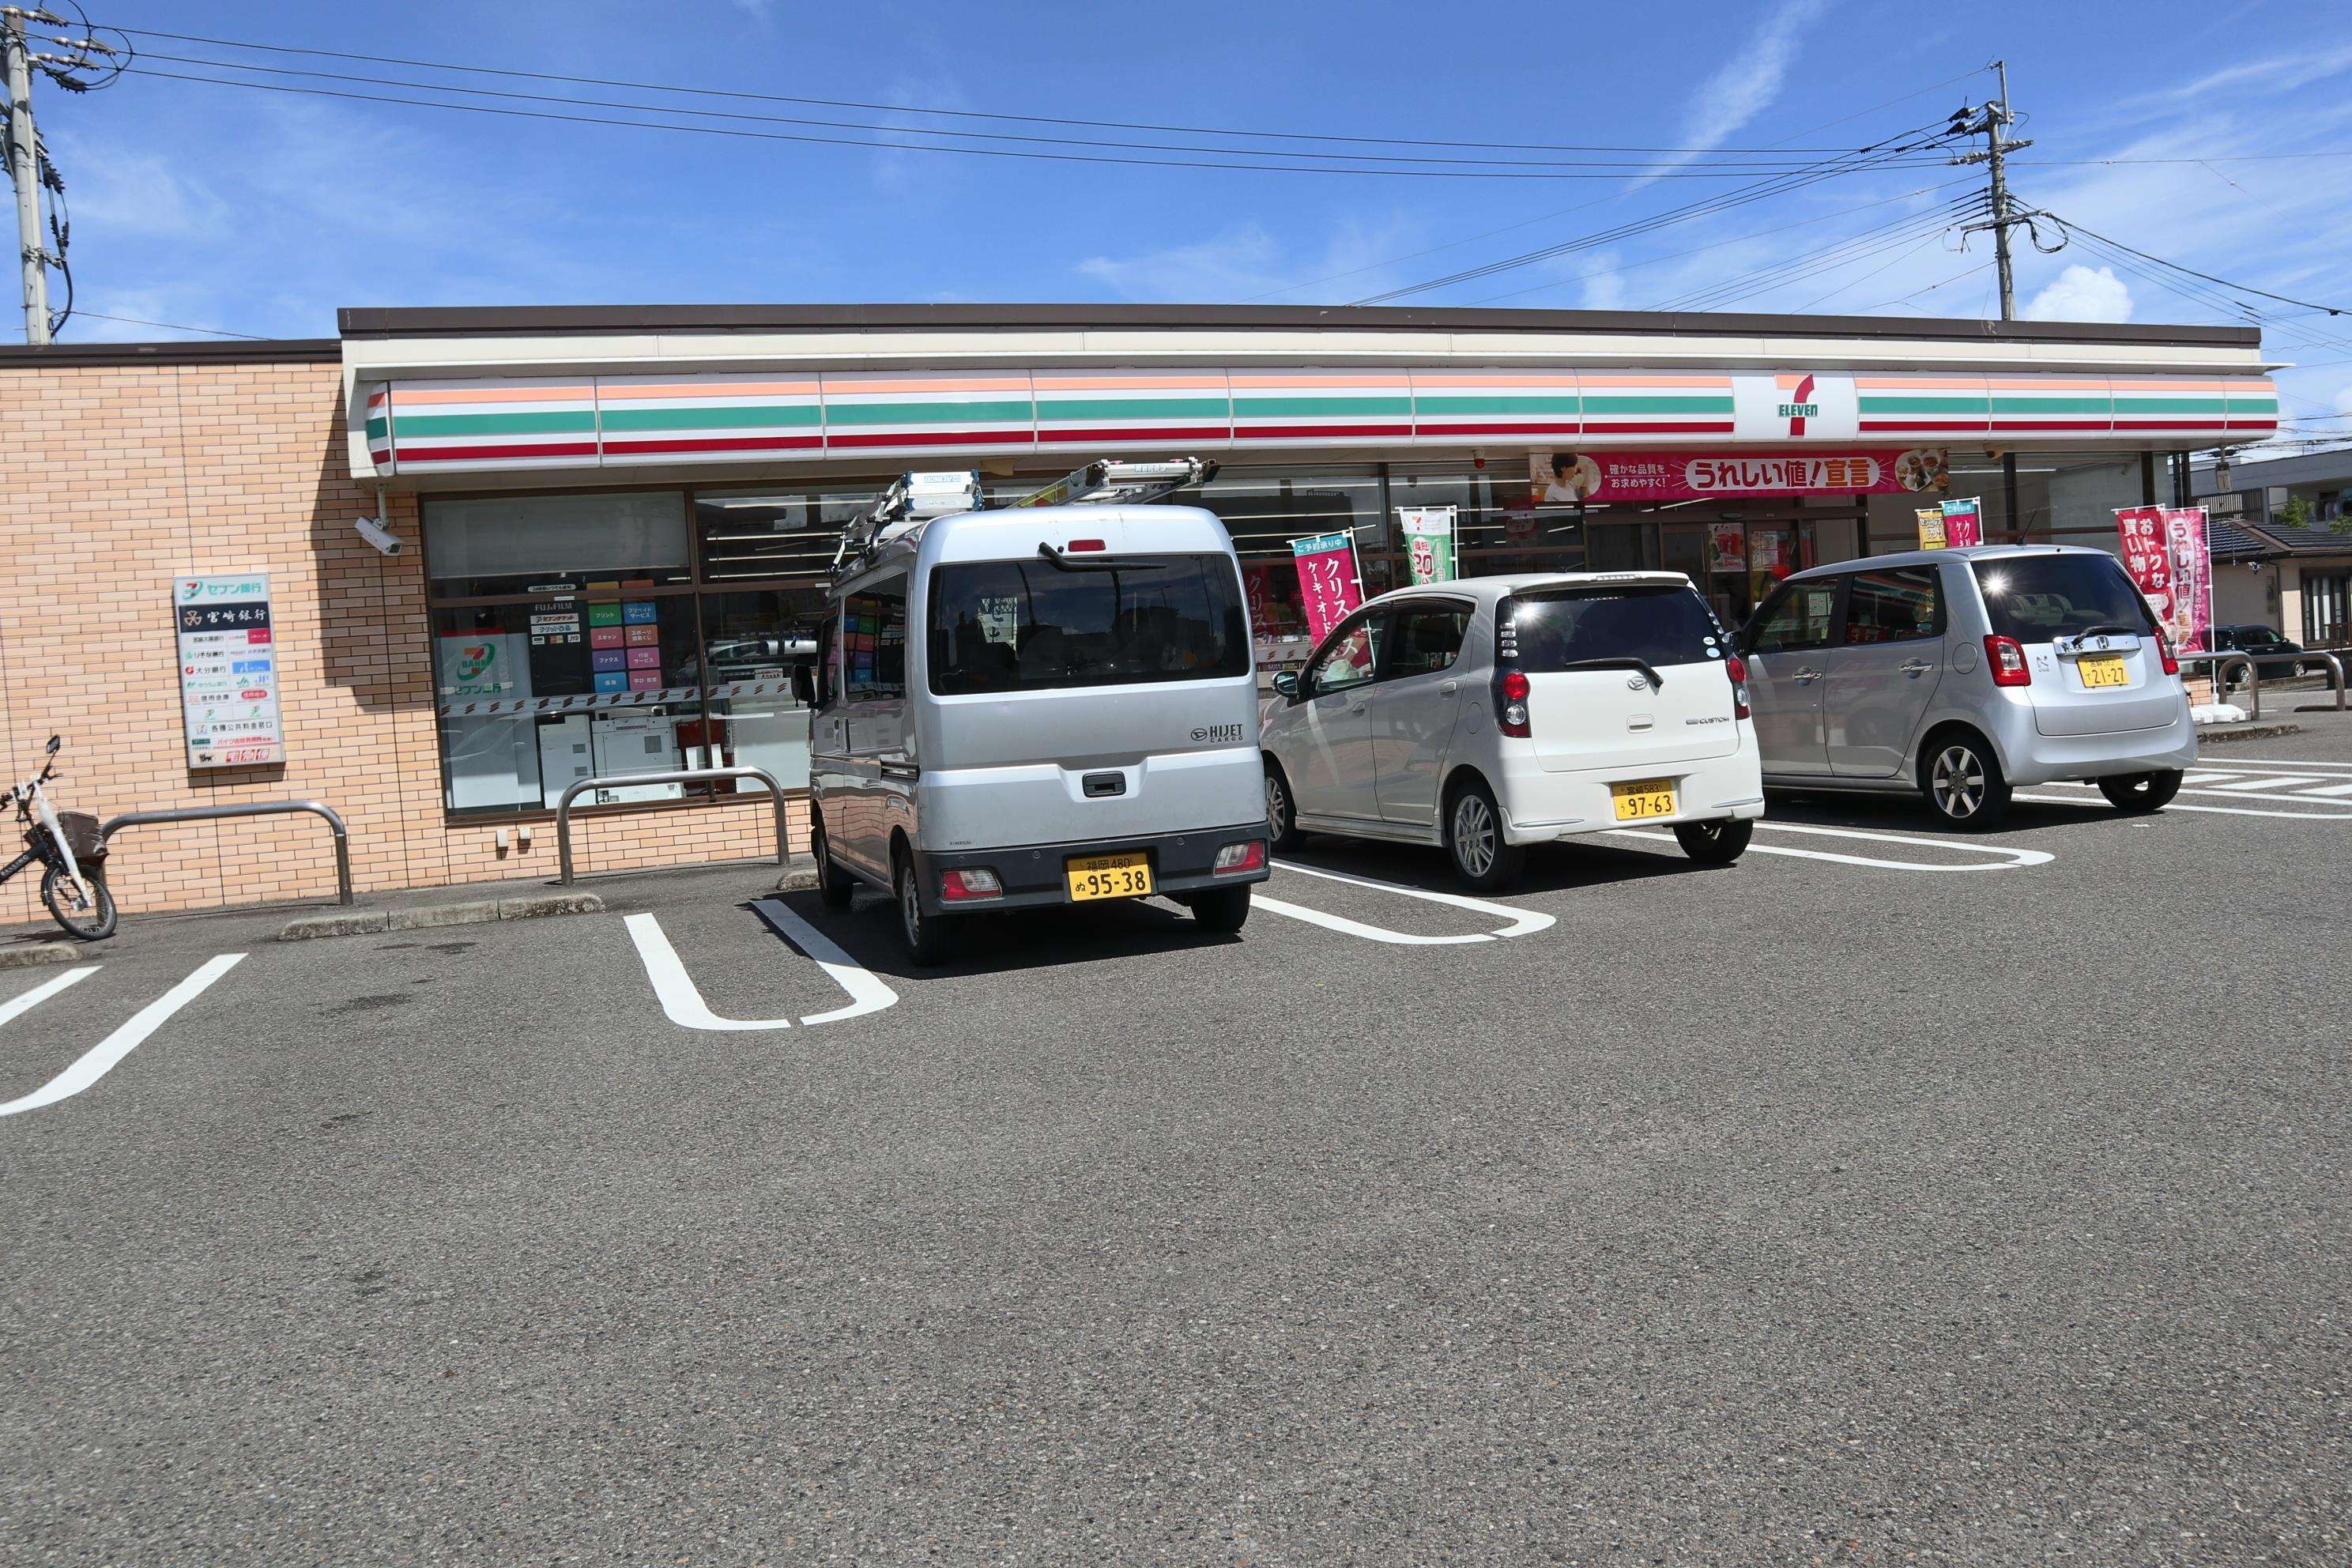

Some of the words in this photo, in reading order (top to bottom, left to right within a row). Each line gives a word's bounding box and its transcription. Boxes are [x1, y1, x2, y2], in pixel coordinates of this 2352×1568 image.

[1774, 373, 1815, 436] 7
[1609, 463, 1665, 475] 確かな品質を
[1611, 477, 1666, 488] お求めやすく!
[1297, 538, 1343, 552] ご予約承り中
[2140, 518, 2165, 589] おトクな
[1325, 557, 1351, 624] クリス
[1307, 561, 1332, 639] ケーキ・オード
[207, 609, 266, 623] 宮崎銀行
[2091, 668, 2124, 684] 21-27
[212, 722, 273, 733] 各種公共料金窓口
[1209, 724, 1242, 737] HIJET
[1628, 794, 1672, 816] 97-63
[1087, 859, 1110, 872] 福岡
[1110, 858, 1130, 869] 480
[1087, 870, 1146, 895] 95-38
